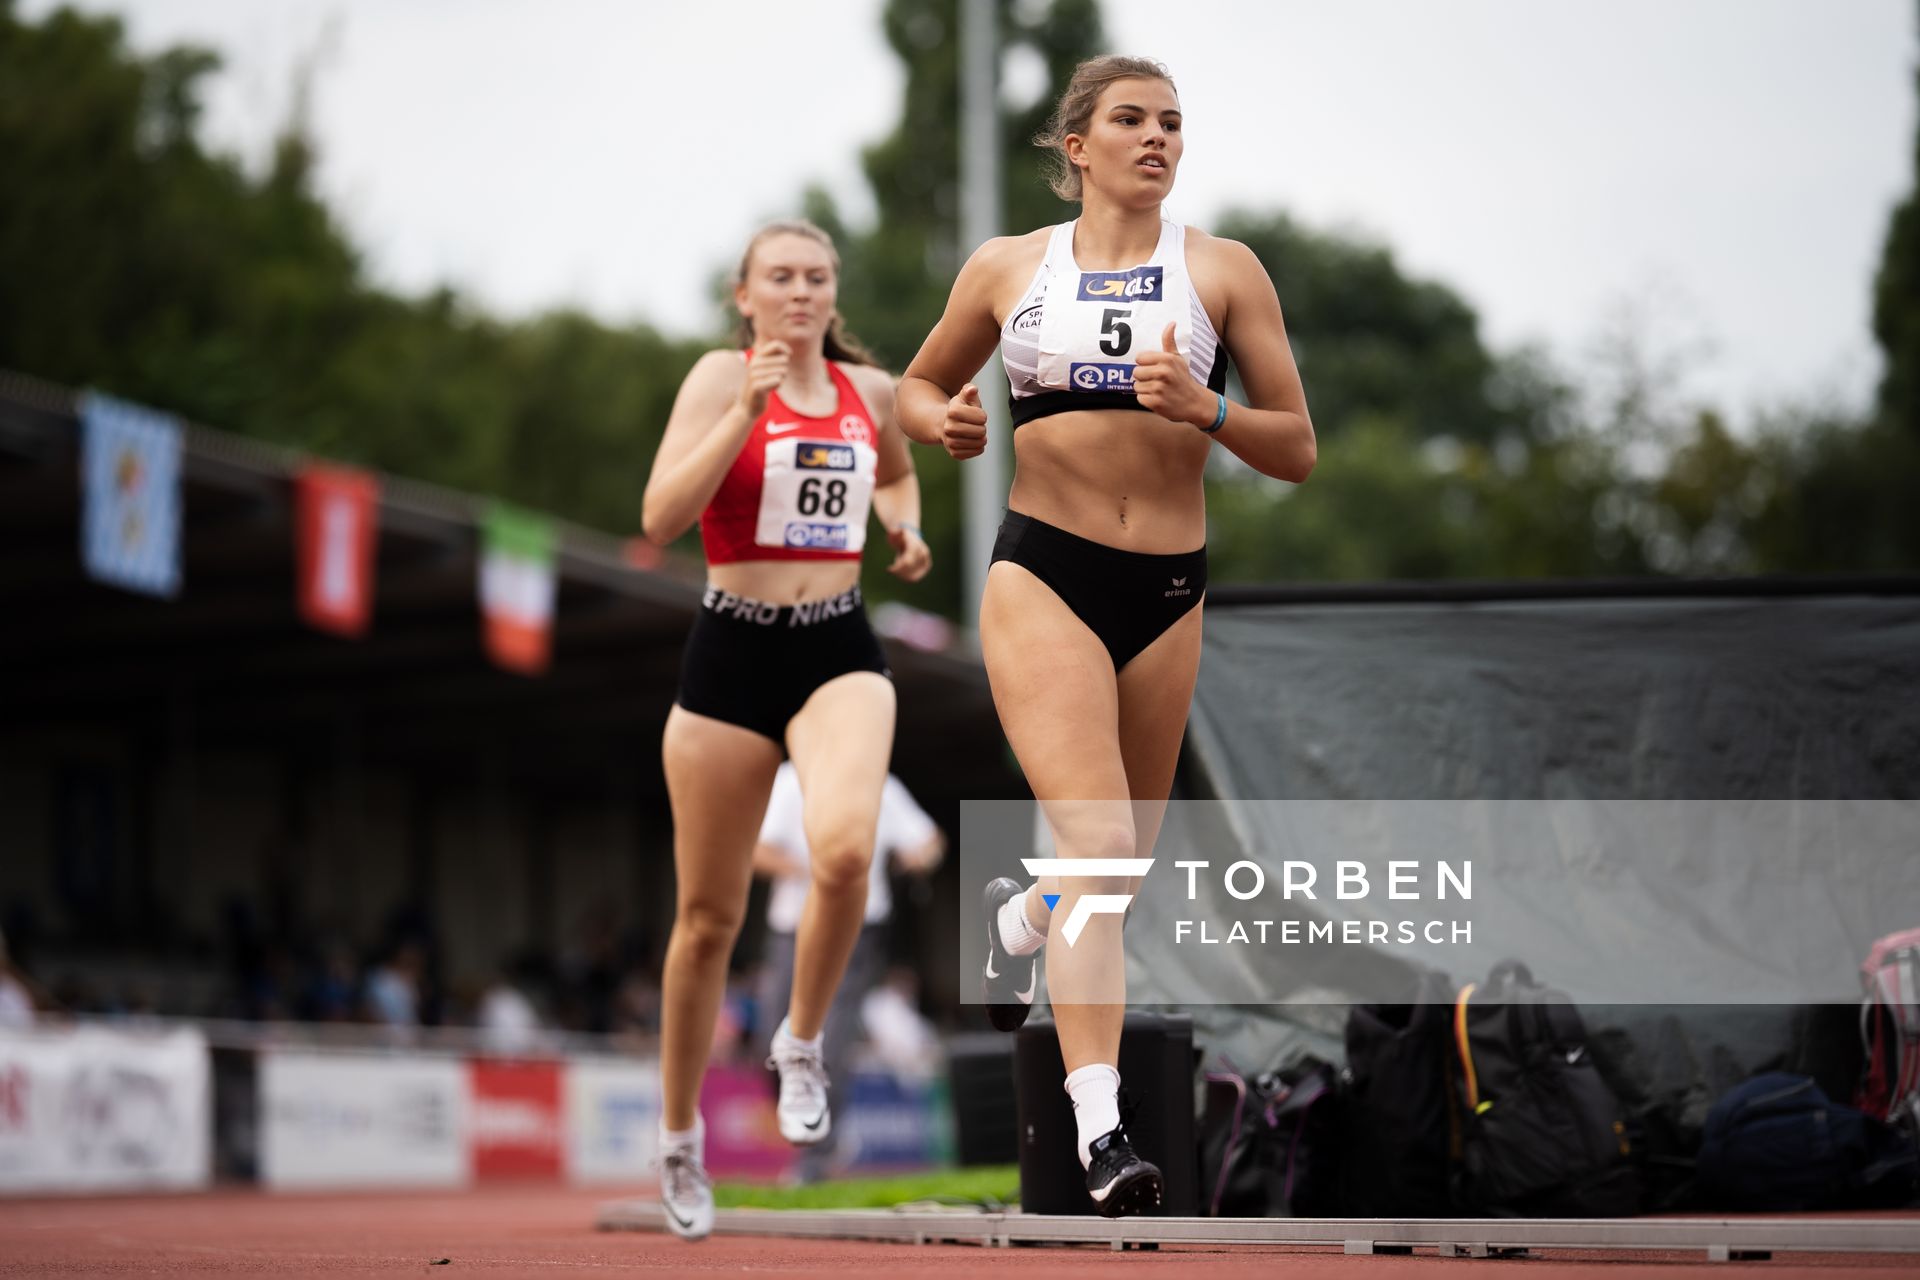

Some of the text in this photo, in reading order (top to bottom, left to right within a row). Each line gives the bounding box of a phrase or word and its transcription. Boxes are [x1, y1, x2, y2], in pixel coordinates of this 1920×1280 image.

[1124, 276, 1155, 297] GLS
[1099, 308, 1132, 357] 5
[797, 477, 847, 518] 68
[1164, 588, 1191, 598] erima
